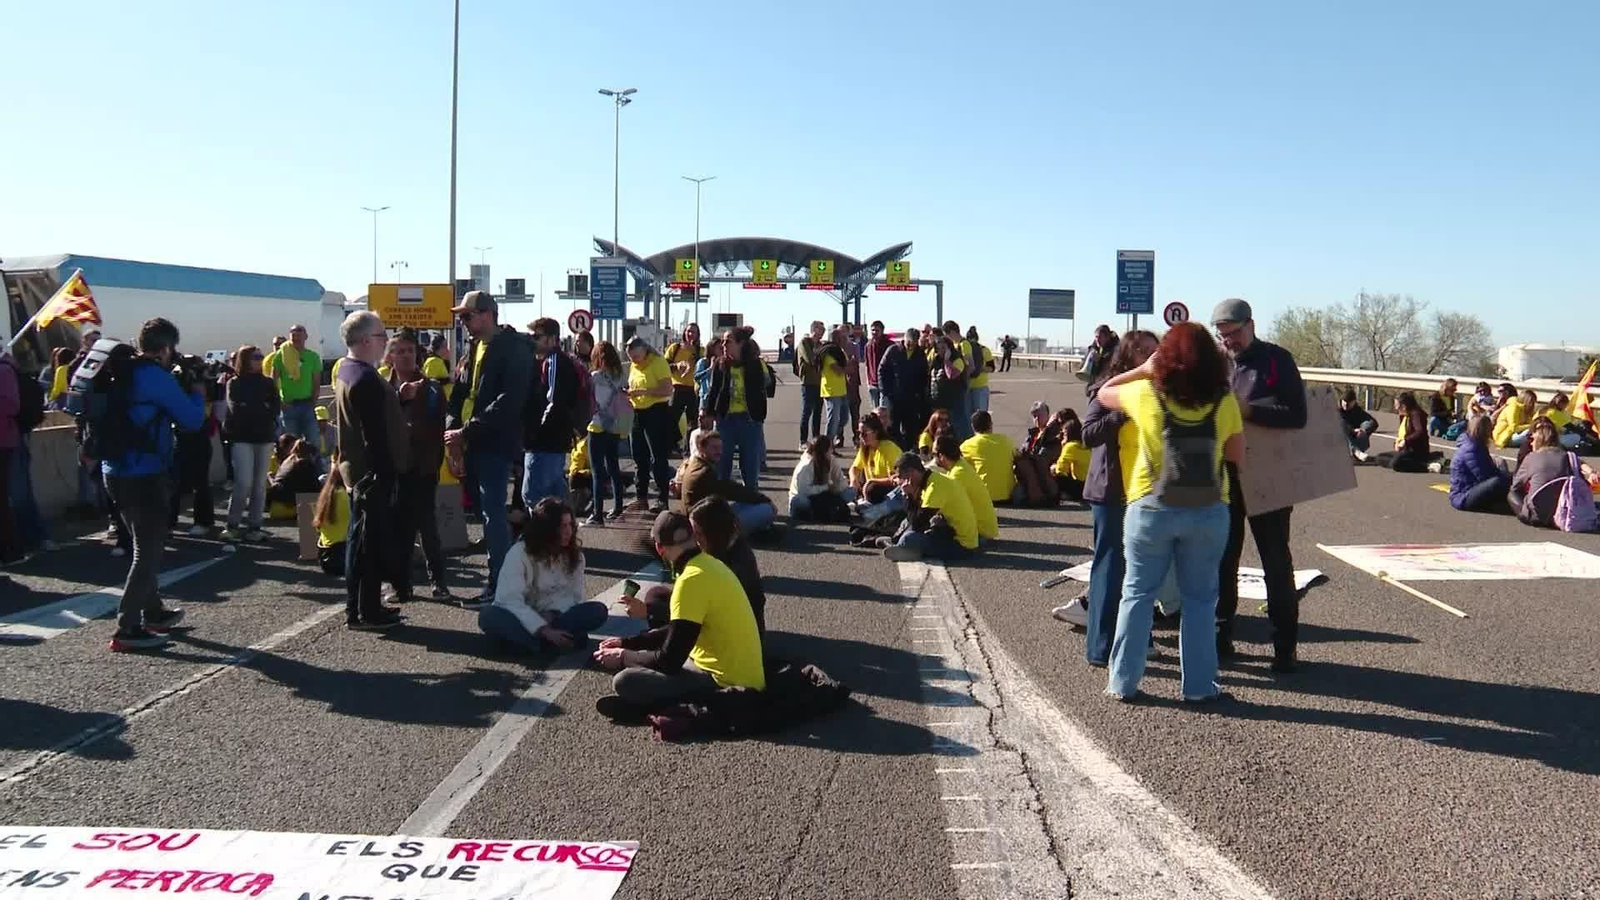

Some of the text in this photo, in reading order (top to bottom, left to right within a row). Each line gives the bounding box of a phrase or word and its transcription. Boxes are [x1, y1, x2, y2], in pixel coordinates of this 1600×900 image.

[72, 833, 200, 851] SOU
[326, 840, 632, 867] ELS RECURSOS
[84, 869, 275, 896] PERTOCA
[381, 863, 480, 882] QUE
